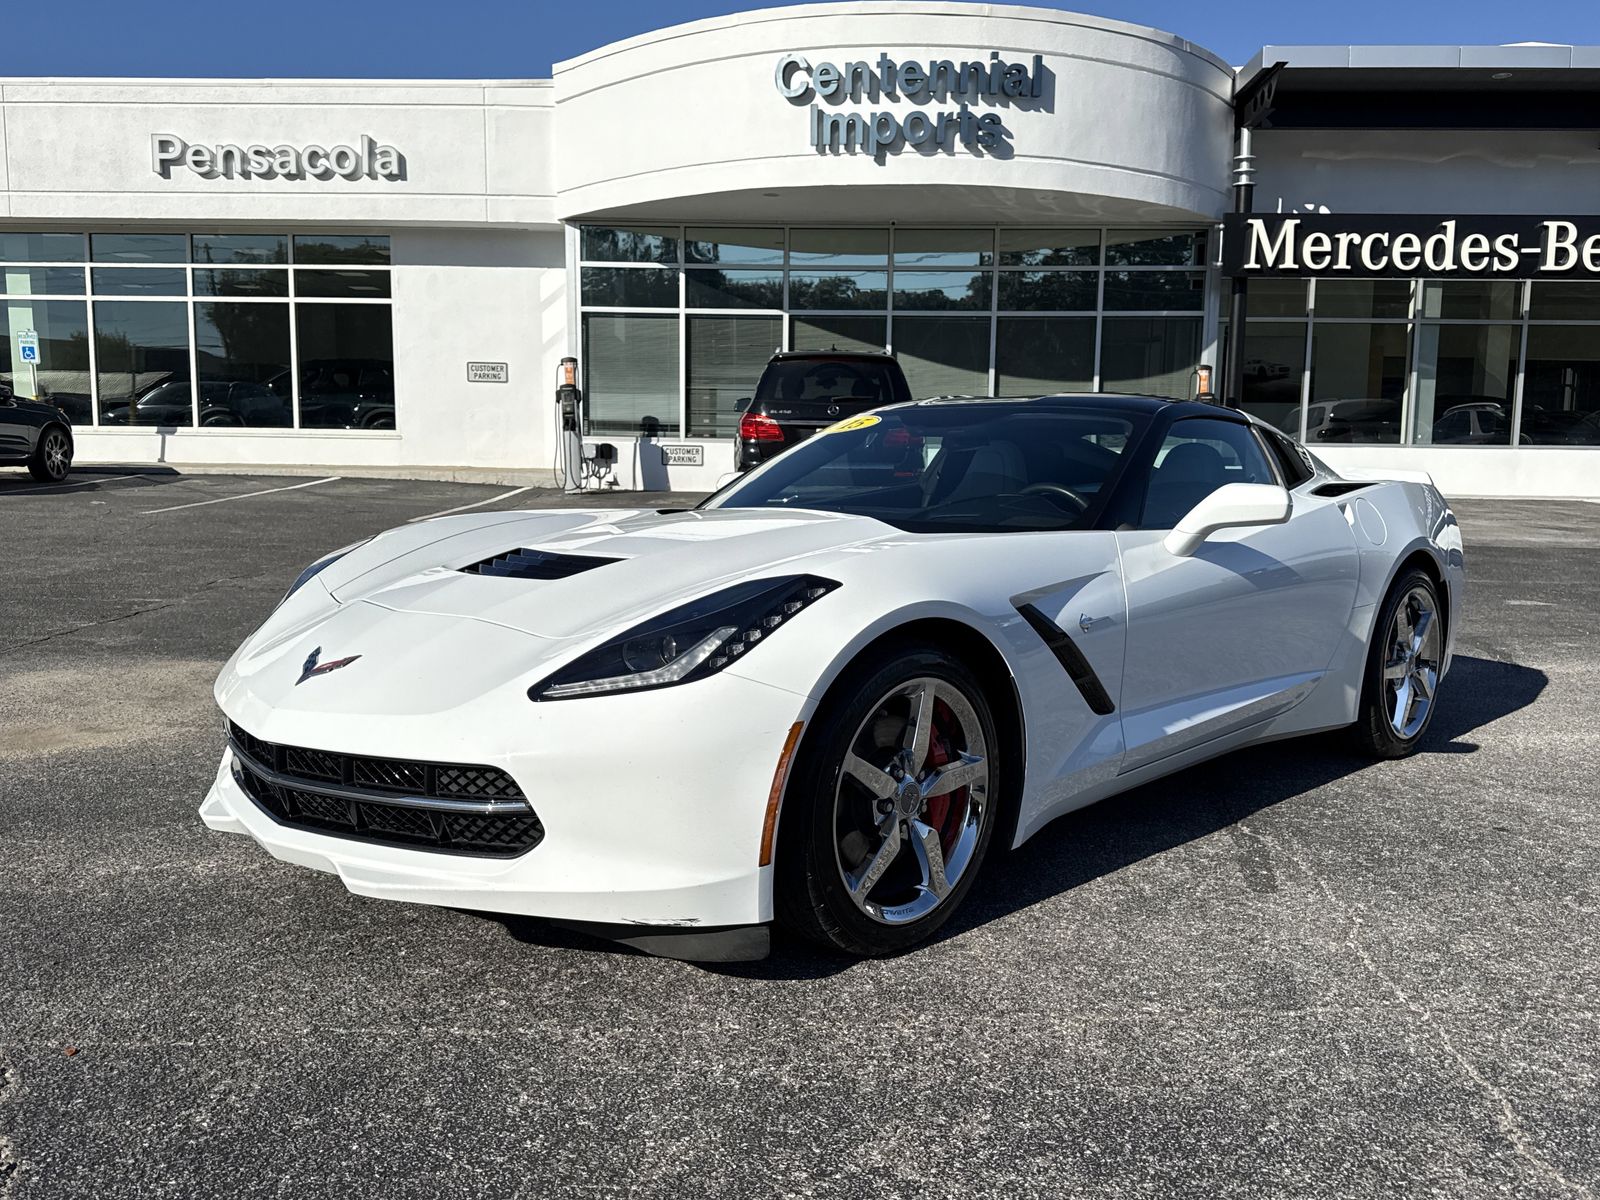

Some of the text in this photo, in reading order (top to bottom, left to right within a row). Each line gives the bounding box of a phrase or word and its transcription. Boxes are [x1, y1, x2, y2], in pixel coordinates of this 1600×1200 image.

[775, 51, 1045, 99] Centennial
[810, 103, 1002, 155] Imports
[151, 132, 403, 177] Pensacola
[470, 364, 504, 372] CUSTOMER
[473, 372, 502, 380] PARKING
[668, 455, 697, 463] PARKING
[880, 906, 913, 915] ORVETTE
